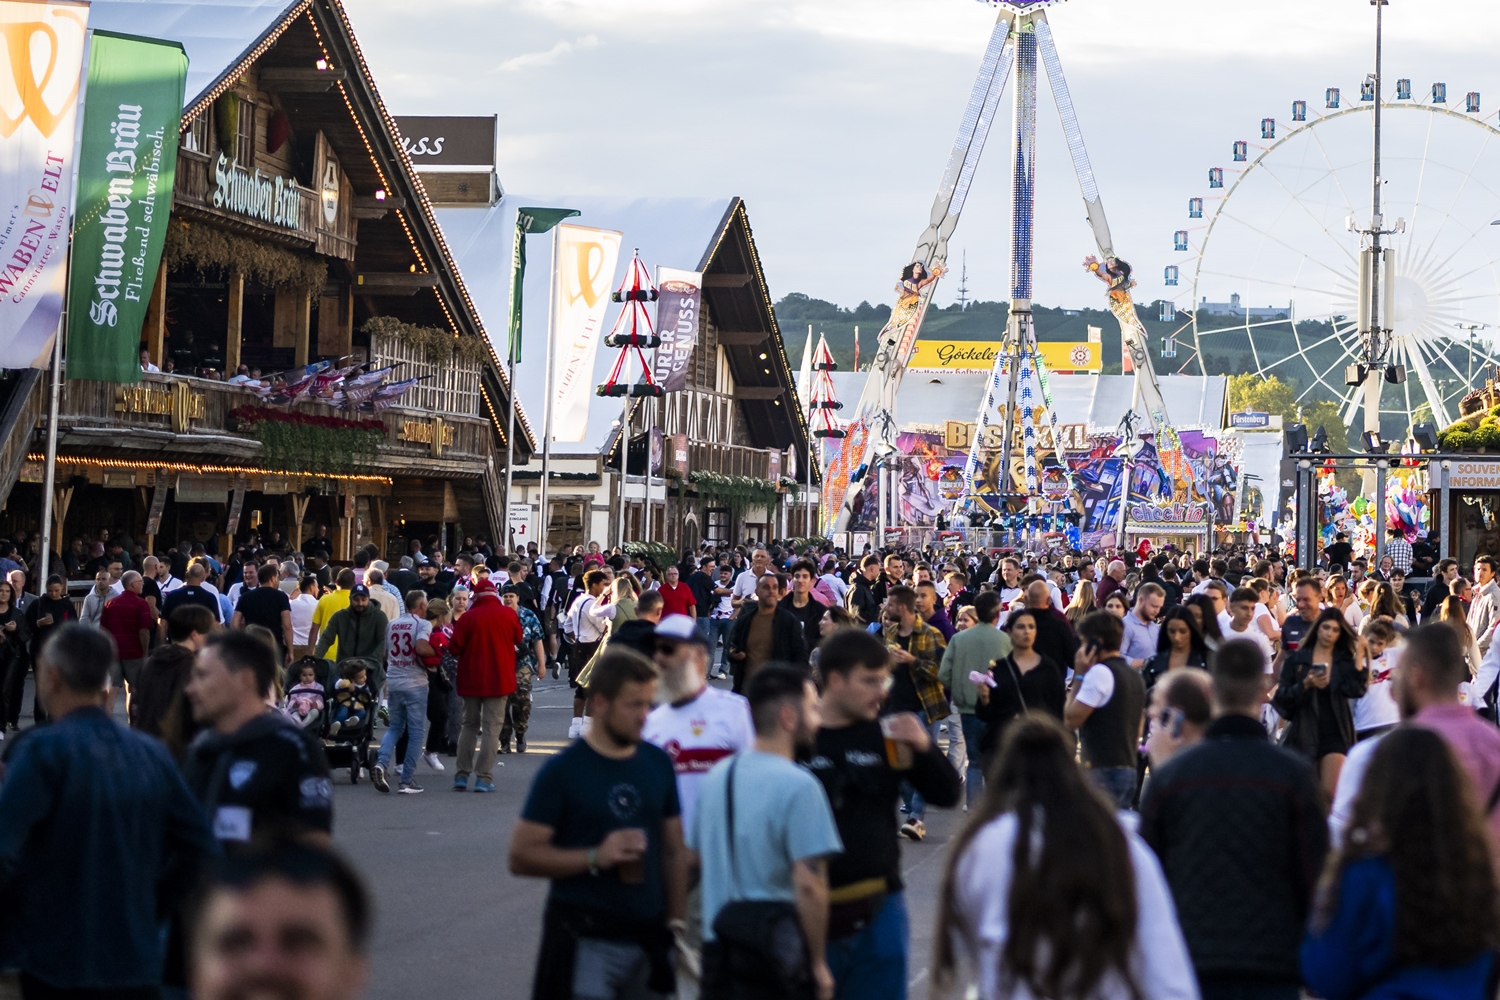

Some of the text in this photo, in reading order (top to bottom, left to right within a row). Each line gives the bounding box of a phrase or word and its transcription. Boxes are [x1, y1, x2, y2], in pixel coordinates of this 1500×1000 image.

[89, 103, 143, 328] Schwaben Bräu
[125, 126, 165, 303] Fließend schwäbisch.
[213, 151, 273, 222] Schwaben
[273, 176, 300, 230] Bräu
[12, 206, 67, 304] Cannstatter Wasen
[673, 298, 695, 372] GENUSS
[1233, 414, 1266, 425] Fürstenberg
[1131, 501, 1204, 522] check in
[391, 632, 413, 657] 33
